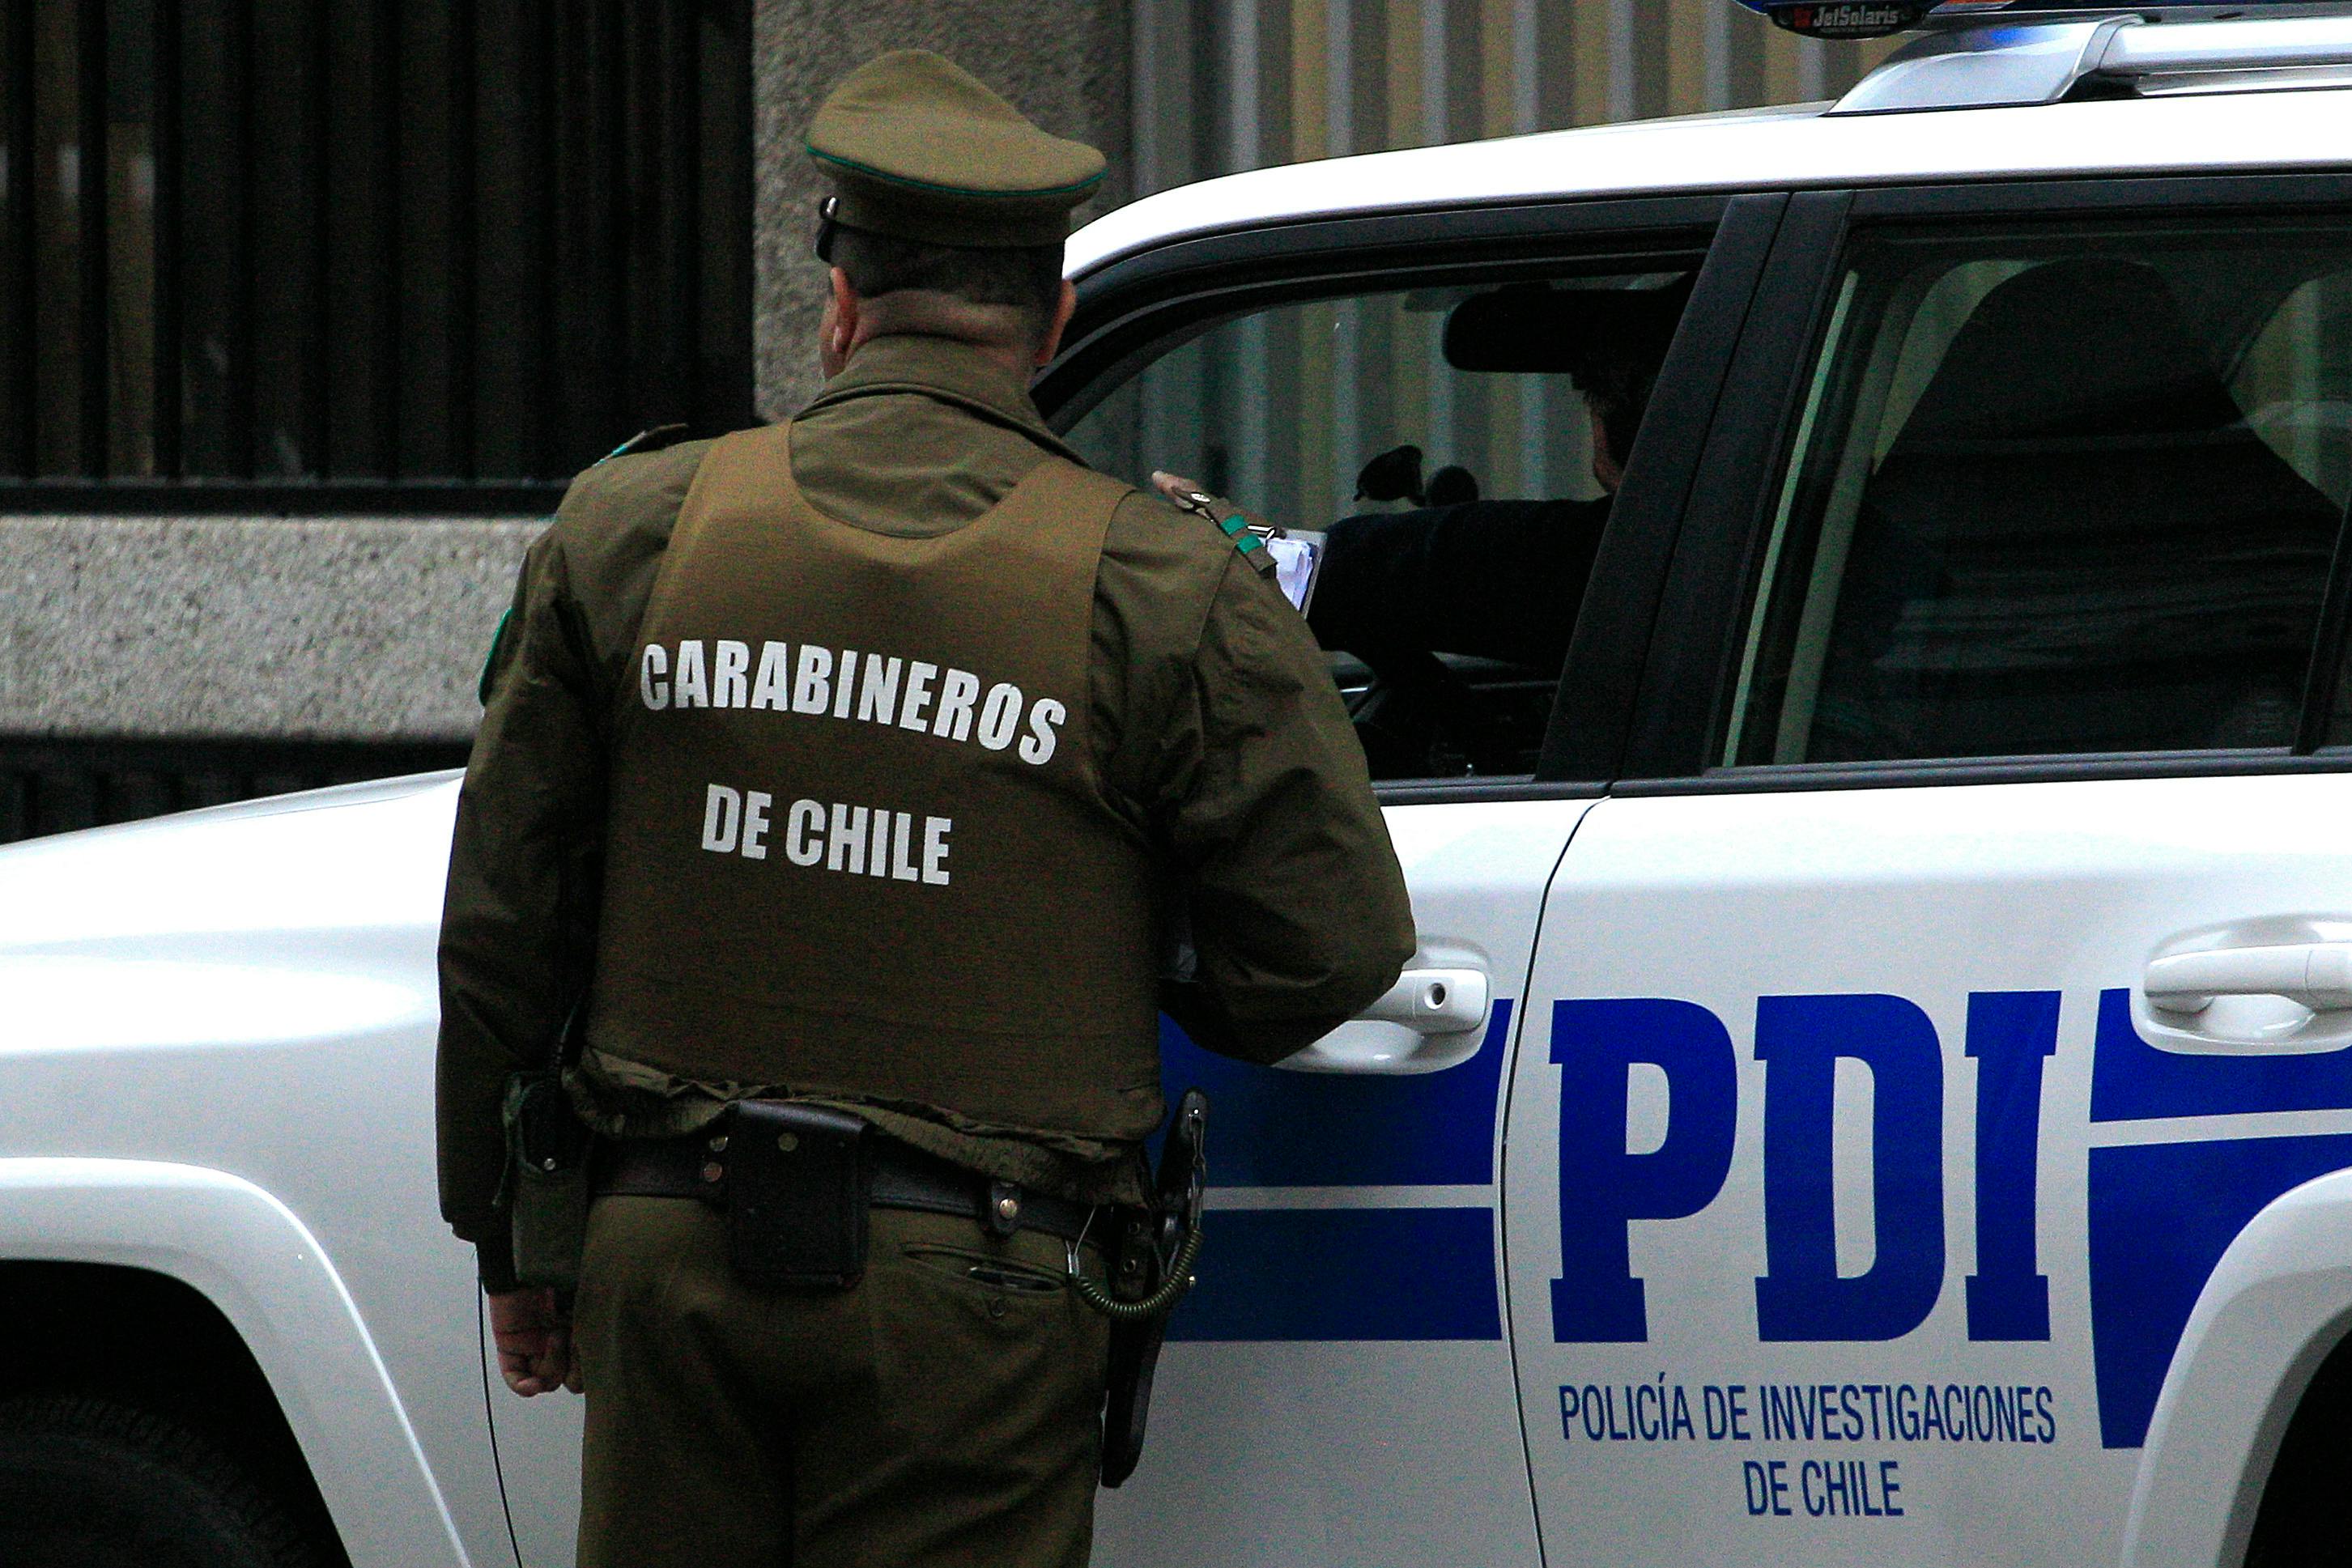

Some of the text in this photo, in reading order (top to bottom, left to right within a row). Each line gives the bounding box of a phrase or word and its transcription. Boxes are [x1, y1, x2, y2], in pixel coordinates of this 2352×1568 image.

[1813, 6, 1899, 27] JetSolaris
[640, 640, 1066, 765] CARABINEROS
[701, 783, 951, 886] DE CHILE
[1549, 990, 2062, 1343] PDI
[1559, 1371, 2056, 1443] POLICÍA DE INVESTIGACIONES
[1743, 1460, 1904, 1516] DE CHILE
